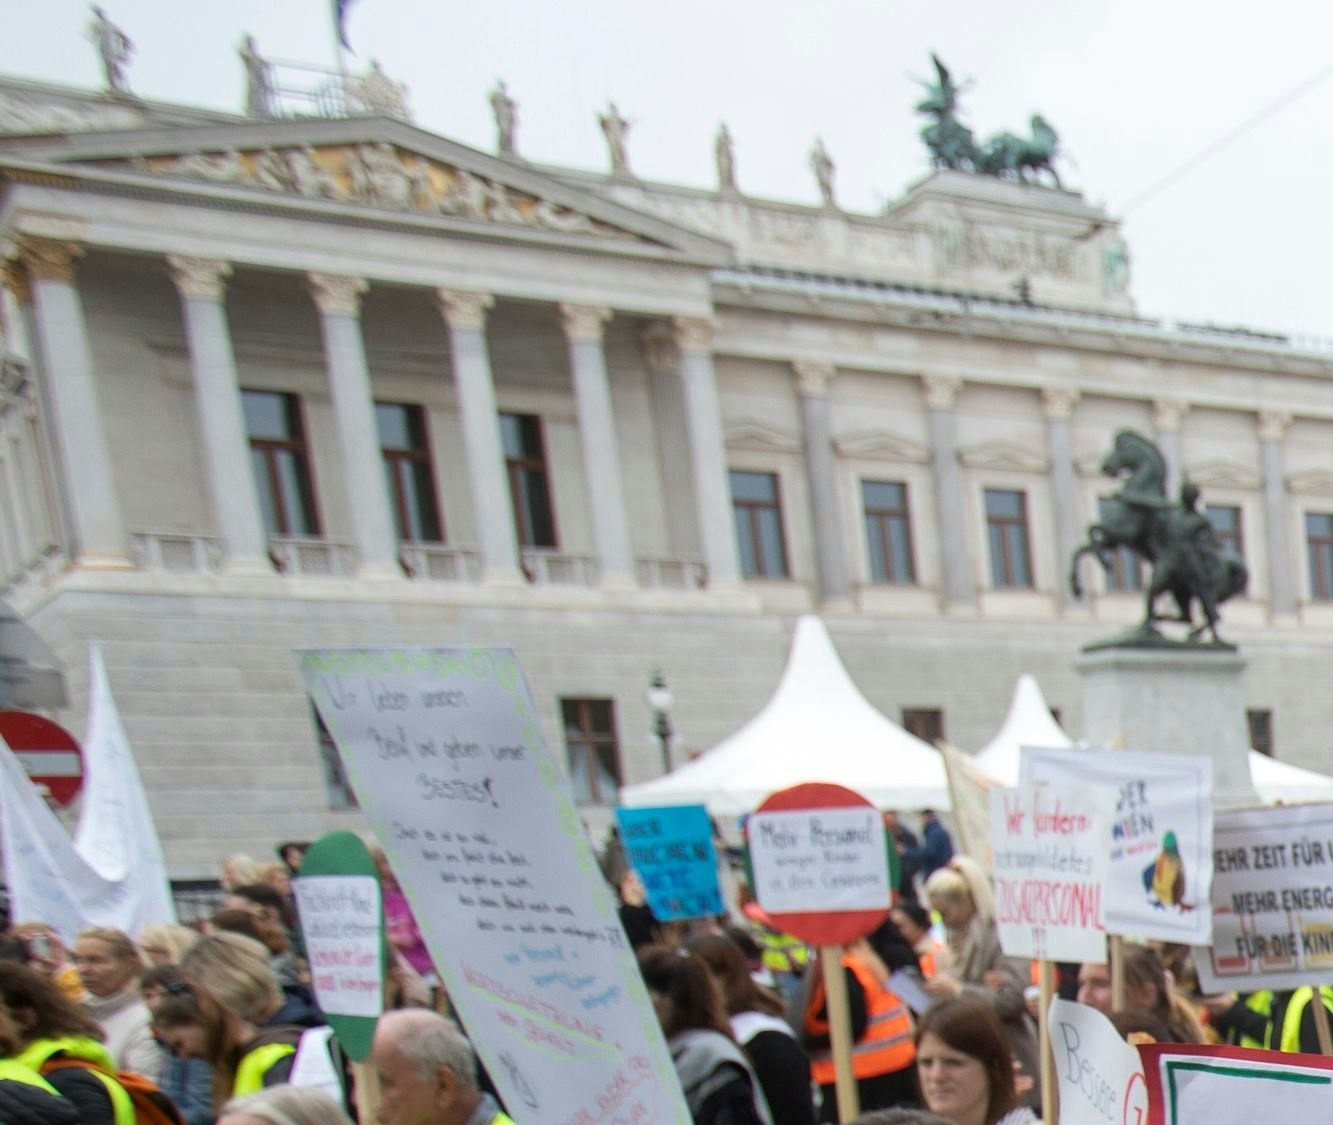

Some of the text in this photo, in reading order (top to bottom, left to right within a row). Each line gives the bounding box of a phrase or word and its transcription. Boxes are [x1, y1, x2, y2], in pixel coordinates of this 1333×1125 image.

[1253, 845, 1286, 869] ZEIT
[1292, 836, 1324, 866] FÜR
[1232, 893, 1277, 914] MEHR
[1235, 935, 1266, 957] FÜR
[1275, 933, 1298, 956] DIE
